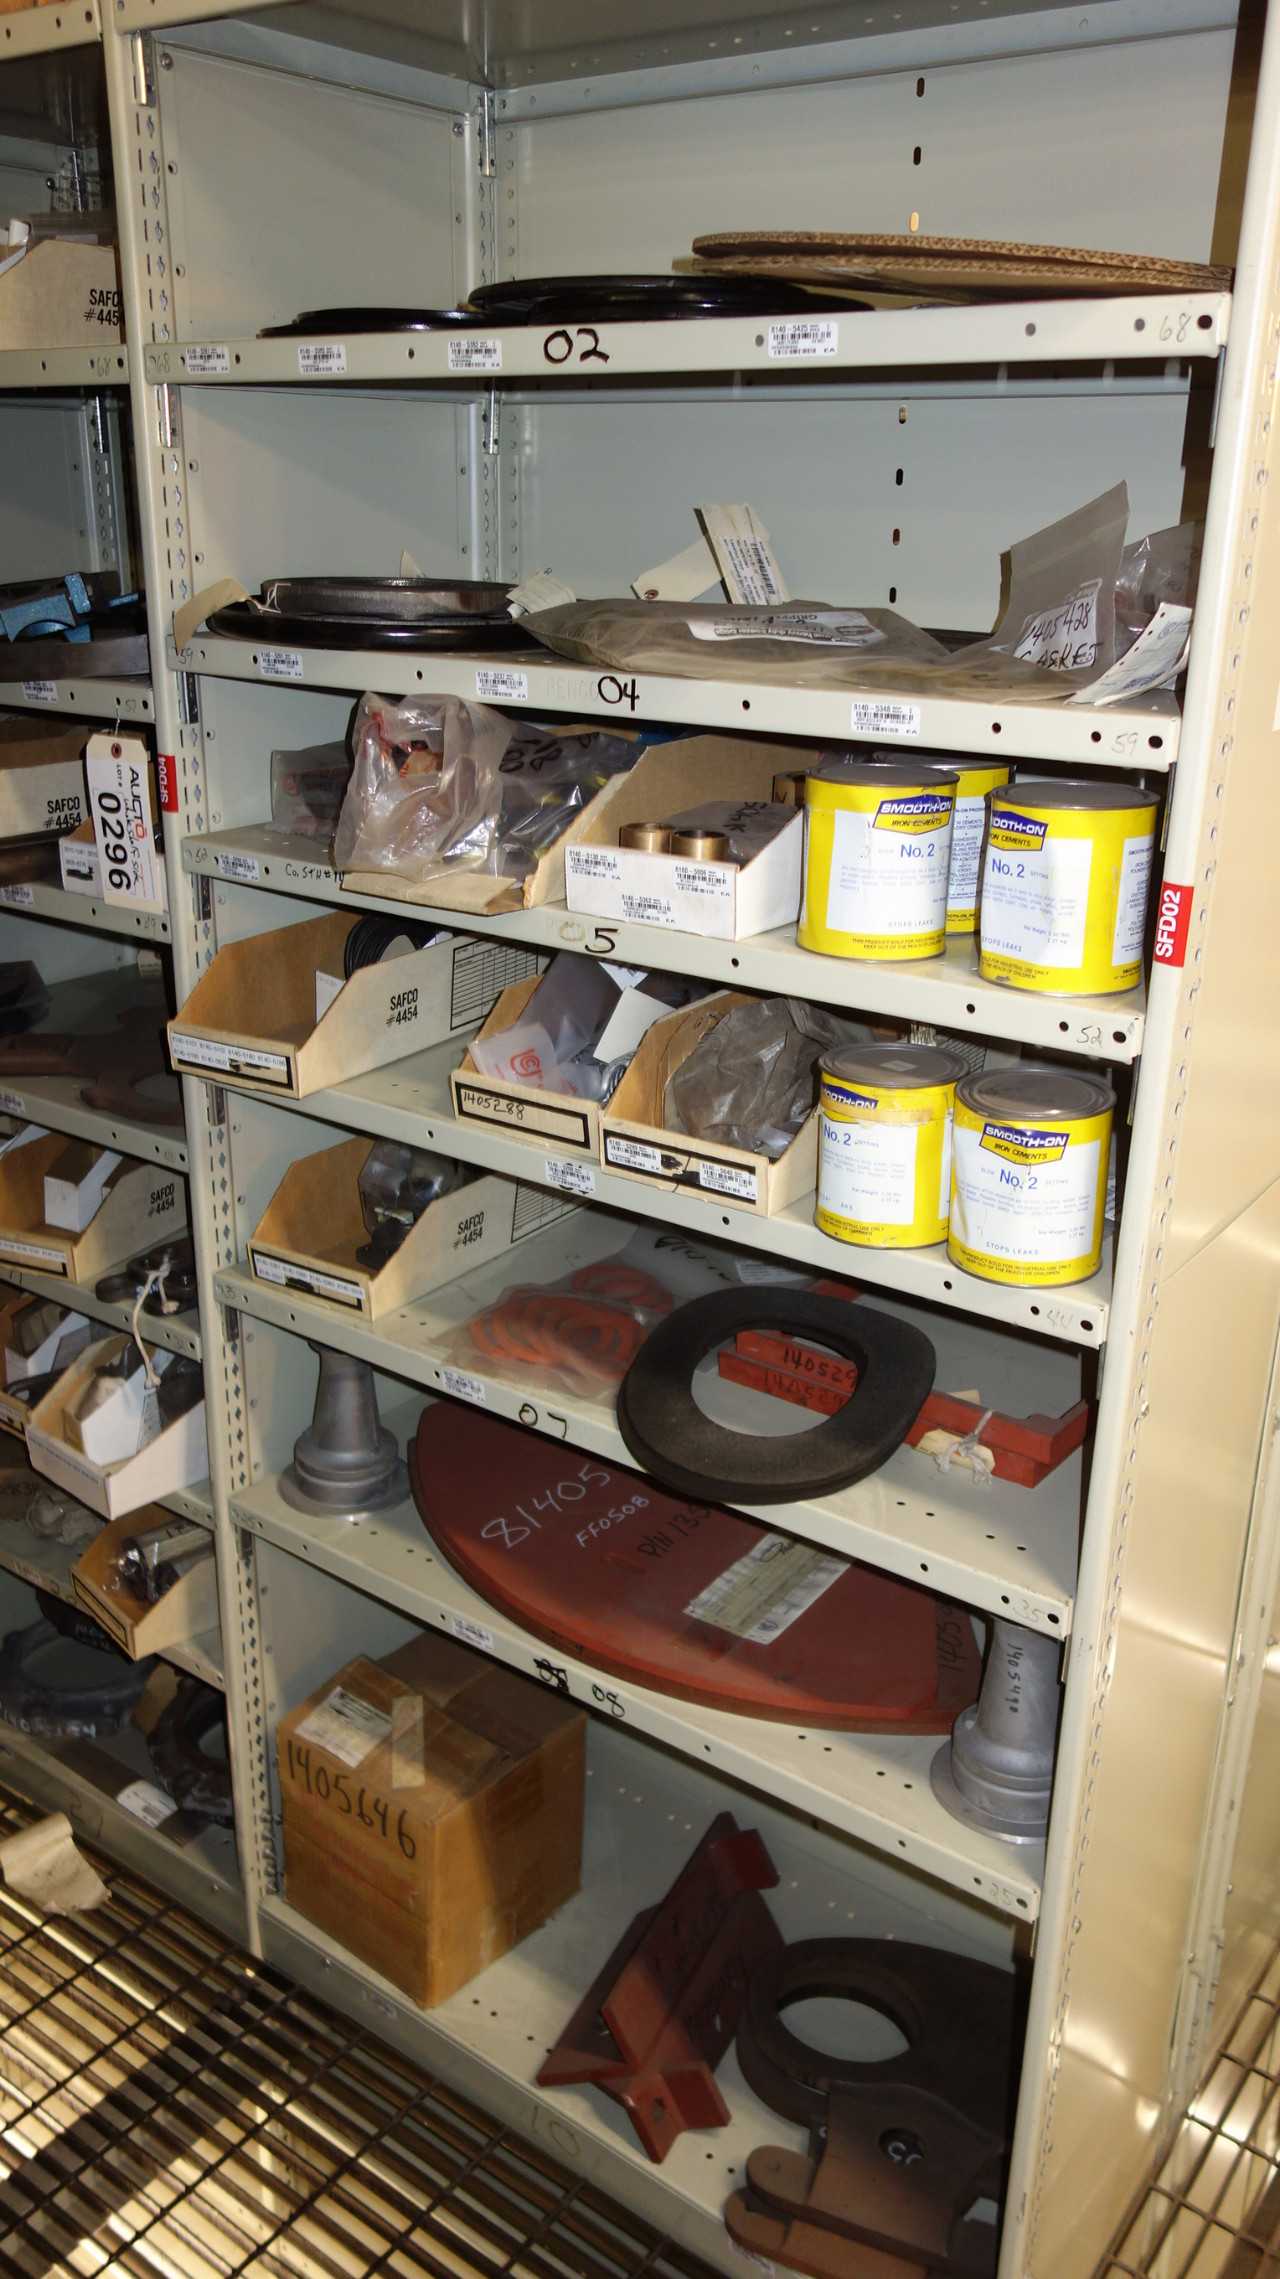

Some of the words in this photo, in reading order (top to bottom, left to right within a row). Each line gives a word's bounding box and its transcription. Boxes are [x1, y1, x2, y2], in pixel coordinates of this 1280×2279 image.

[89, 288, 119, 307] SAFC
[84, 308, 120, 326] #445
[1160, 312, 1192, 343] 68
[543, 328, 610, 365] 02
[598, 675, 640, 711] 04
[157, 755, 169, 803] SFD04
[47, 796, 80, 814] SAFCO
[880, 796, 953, 815] SMOOTH-ON
[43, 811, 82, 829] #4454
[992, 816, 1045, 836] OOTH-ON
[98, 791, 132, 890] 0296
[900, 843, 925, 858] No.
[927, 842, 936, 857] 2
[991, 858, 1013, 877] No.
[1016, 863, 1025, 878] 2
[1155, 889, 1181, 958] SFD02
[390, 987, 419, 1012] SAFCO
[385, 1006, 419, 1027] #4454
[462, 1090, 525, 1121] 1405288
[823, 1087, 877, 1111] OOTH-ON
[823, 1123, 841, 1144] No.
[842, 1132, 852, 1146] 2
[984, 1125, 1069, 1148] SMOOTH-ON
[994, 1142, 1010, 1153] IRON
[1011, 1147, 1049, 1160] CEMENTS
[999, 1168, 1024, 1190] No.
[1027, 1176, 1038, 1190] 2
[150, 1183, 175, 1205] SAFCO
[457, 1211, 485, 1237] SAFCO
[453, 1227, 484, 1250] #4454
[518, 1402, 567, 1440] 07
[480, 1463, 611, 1549] 81405
[287, 1739, 417, 1860] 1405646
